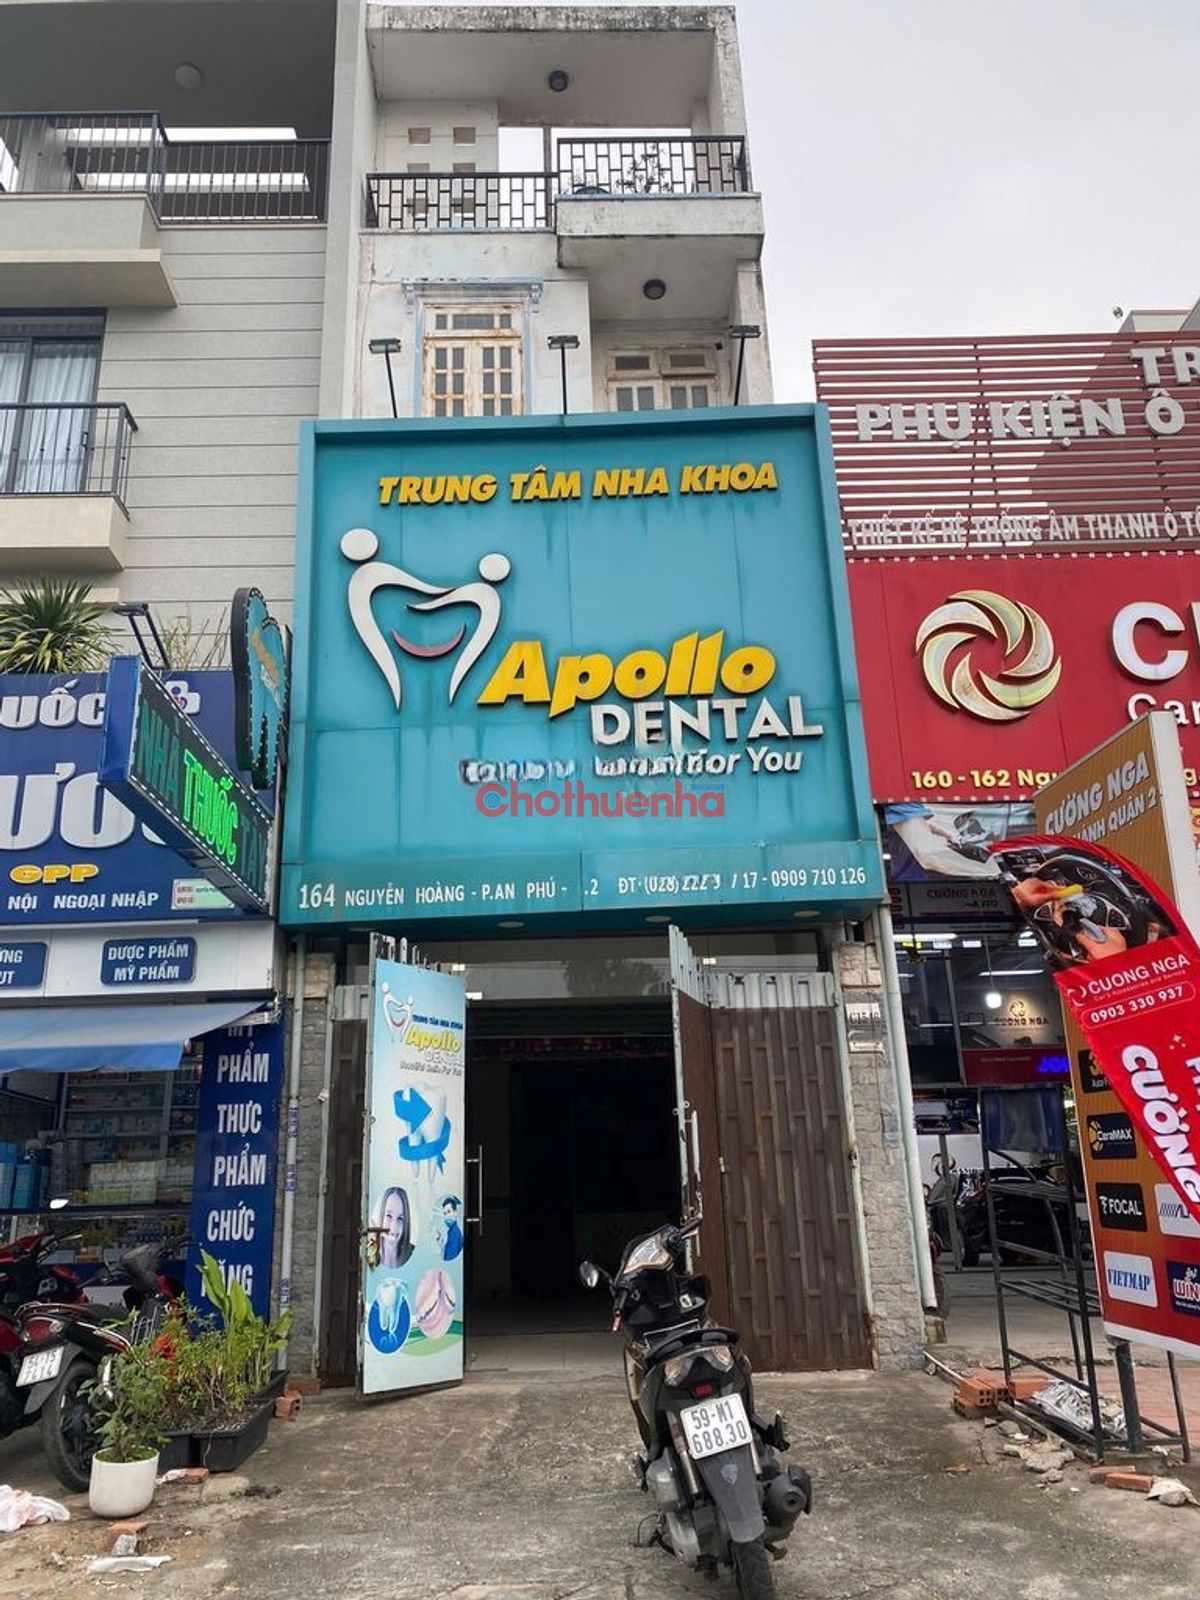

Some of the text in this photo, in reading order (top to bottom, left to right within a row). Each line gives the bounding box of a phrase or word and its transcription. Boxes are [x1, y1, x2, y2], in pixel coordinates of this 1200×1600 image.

[855, 387, 1186, 449] PHỤ KIỆN Ô
[379, 462, 779, 505] TRUNG TÂM NHA KHOA
[847, 509, 903, 545] THIẾT
[910, 508, 937, 544] KẾ
[971, 506, 1043, 543] THỐNG
[1049, 508, 1081, 541] ÂM
[1084, 512, 1160, 539] THANH
[1164, 505, 1179, 538] Ô
[476, 630, 777, 721] Apollo
[590, 694, 824, 748] DENTAL
[746, 746, 803, 773] You
[1106, 751, 1150, 801] NGA
[911, 770, 953, 789] 160
[970, 769, 1011, 788] 162
[1148, 786, 1158, 808] 2
[9, 863, 100, 884] GPP
[299, 882, 336, 910] 164
[415, 881, 465, 904] HOÀNG
[481, 883, 516, 901] P.AN
[526, 876, 557, 900] PHÚ
[771, 869, 808, 887] 0909
[811, 868, 837, 885] 710
[840, 867, 867, 885] 126
[8, 894, 38, 913] NỘI
[53, 893, 106, 912] NGOẠI
[111, 890, 159, 909] NHẬP
[108, 940, 189, 962] DƯỢC PHẨM
[114, 960, 180, 982] MỸ PHẨM
[1088, 953, 1191, 994] CUONG NGA
[1090, 985, 1183, 1024] 0903 330 937
[405, 1024, 462, 1053] Apollo
[217, 1041, 270, 1084] PHẨM
[217, 1100, 262, 1137] THỰC
[213, 1145, 267, 1188] PHẨM
[207, 1200, 255, 1243] CHỨC
[1109, 1198, 1142, 1216] FOCAL
[1108, 1268, 1151, 1292] VIETMAP
[690, 1400, 735, 1431] 59-M1
[691, 1420, 748, 1455] 688.30
